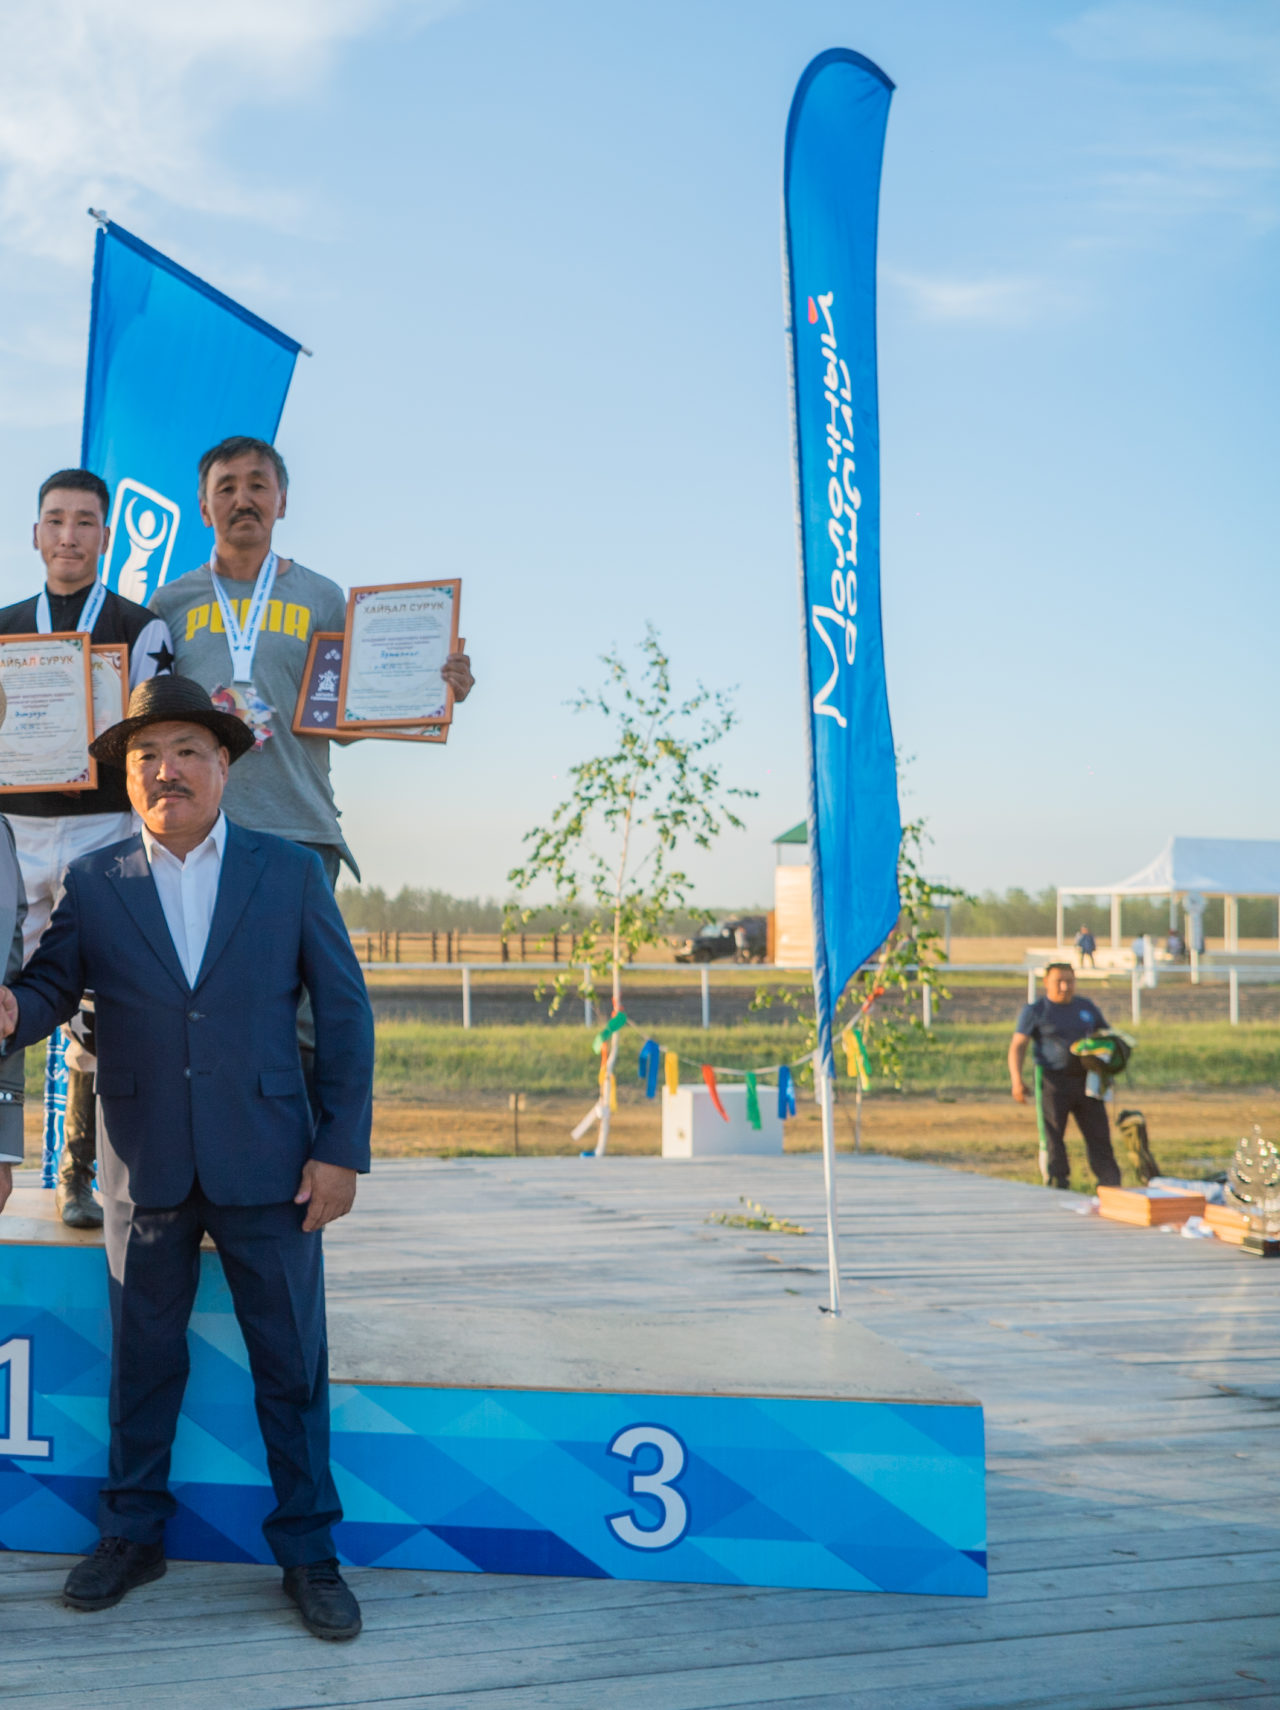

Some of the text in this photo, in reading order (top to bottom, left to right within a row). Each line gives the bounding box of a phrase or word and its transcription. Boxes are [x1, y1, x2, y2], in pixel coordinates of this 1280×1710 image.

[808, 291, 847, 728] Молочный
[184, 598, 311, 642] PUMA
[606, 1423, 690, 1552] 3
